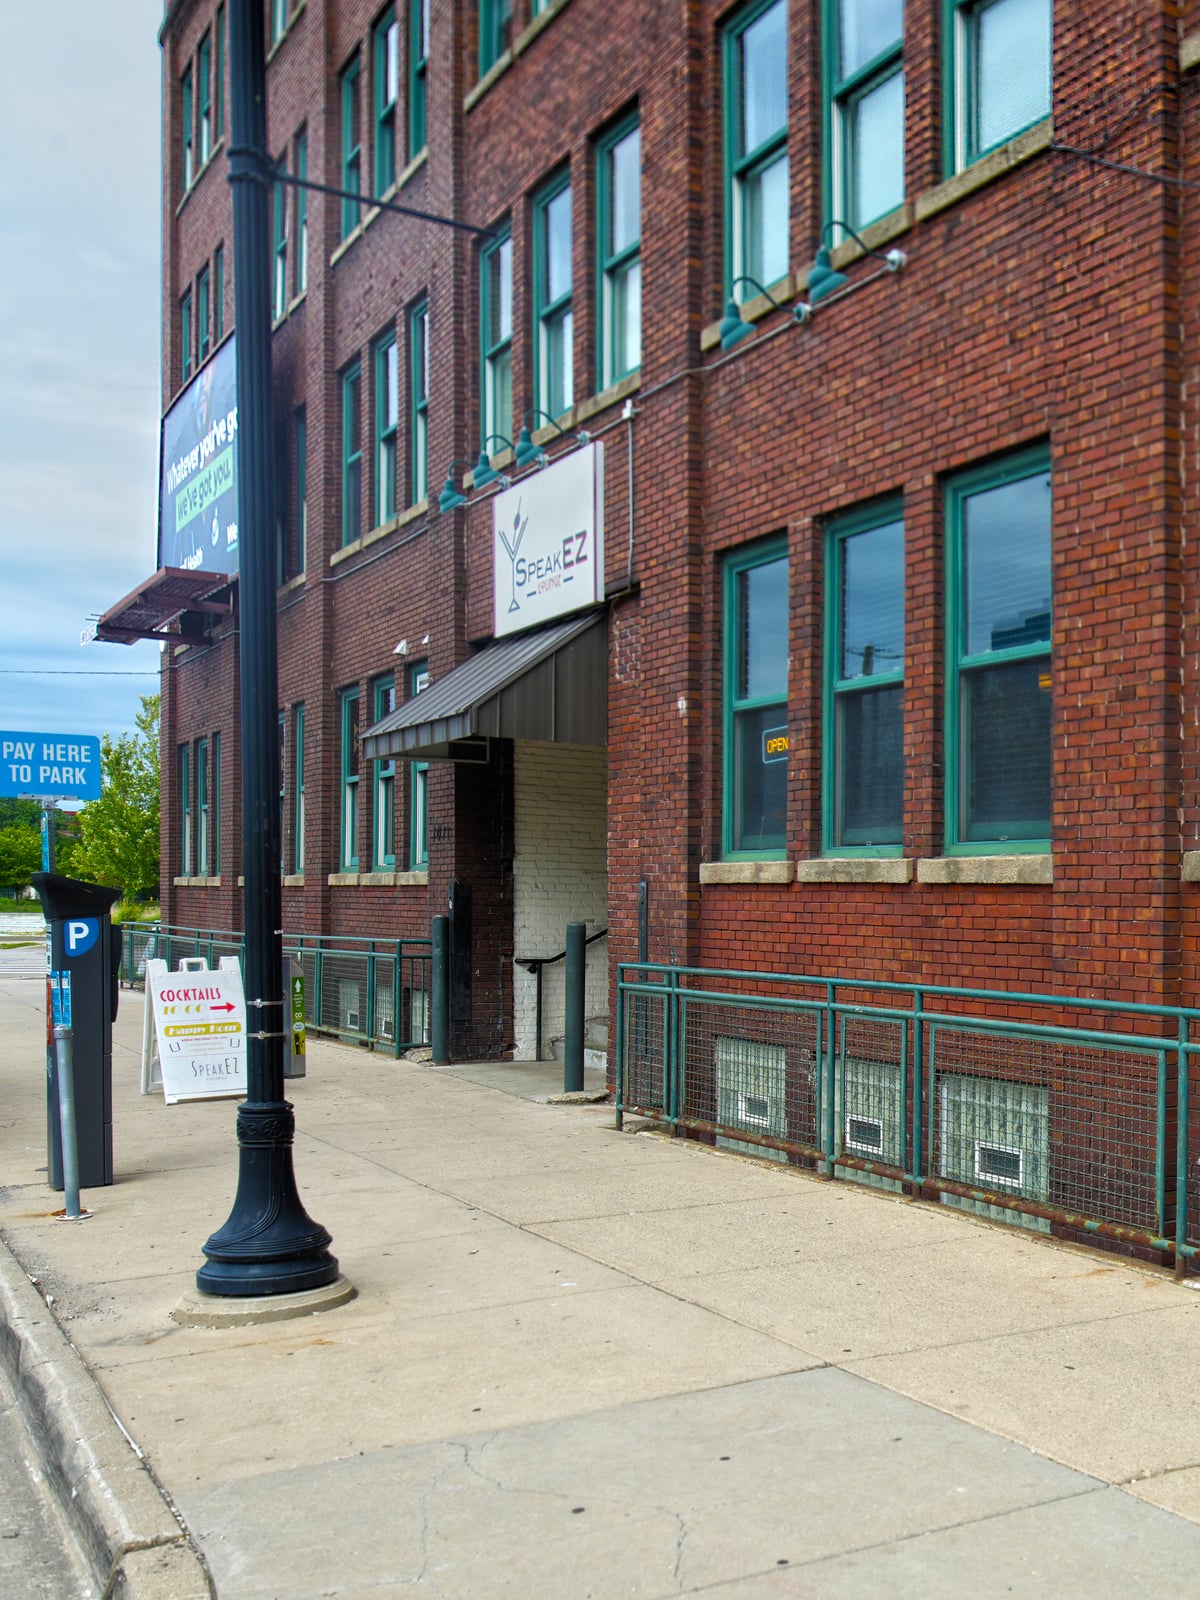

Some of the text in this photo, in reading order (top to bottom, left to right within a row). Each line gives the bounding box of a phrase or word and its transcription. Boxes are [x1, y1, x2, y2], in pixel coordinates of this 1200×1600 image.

[166, 447, 199, 494] Whatever
[199, 419, 226, 470] you've
[177, 463, 231, 522] we've got you.
[538, 574, 561, 594] LOUNGE
[2, 741, 91, 763] PAY HERE
[767, 736, 788, 753] OPEN
[8, 764, 86, 785] TO PARK
[69, 921, 89, 950] P
[160, 987, 221, 1002] COCKTAILS
[168, 1023, 238, 1036] Happy Hour
